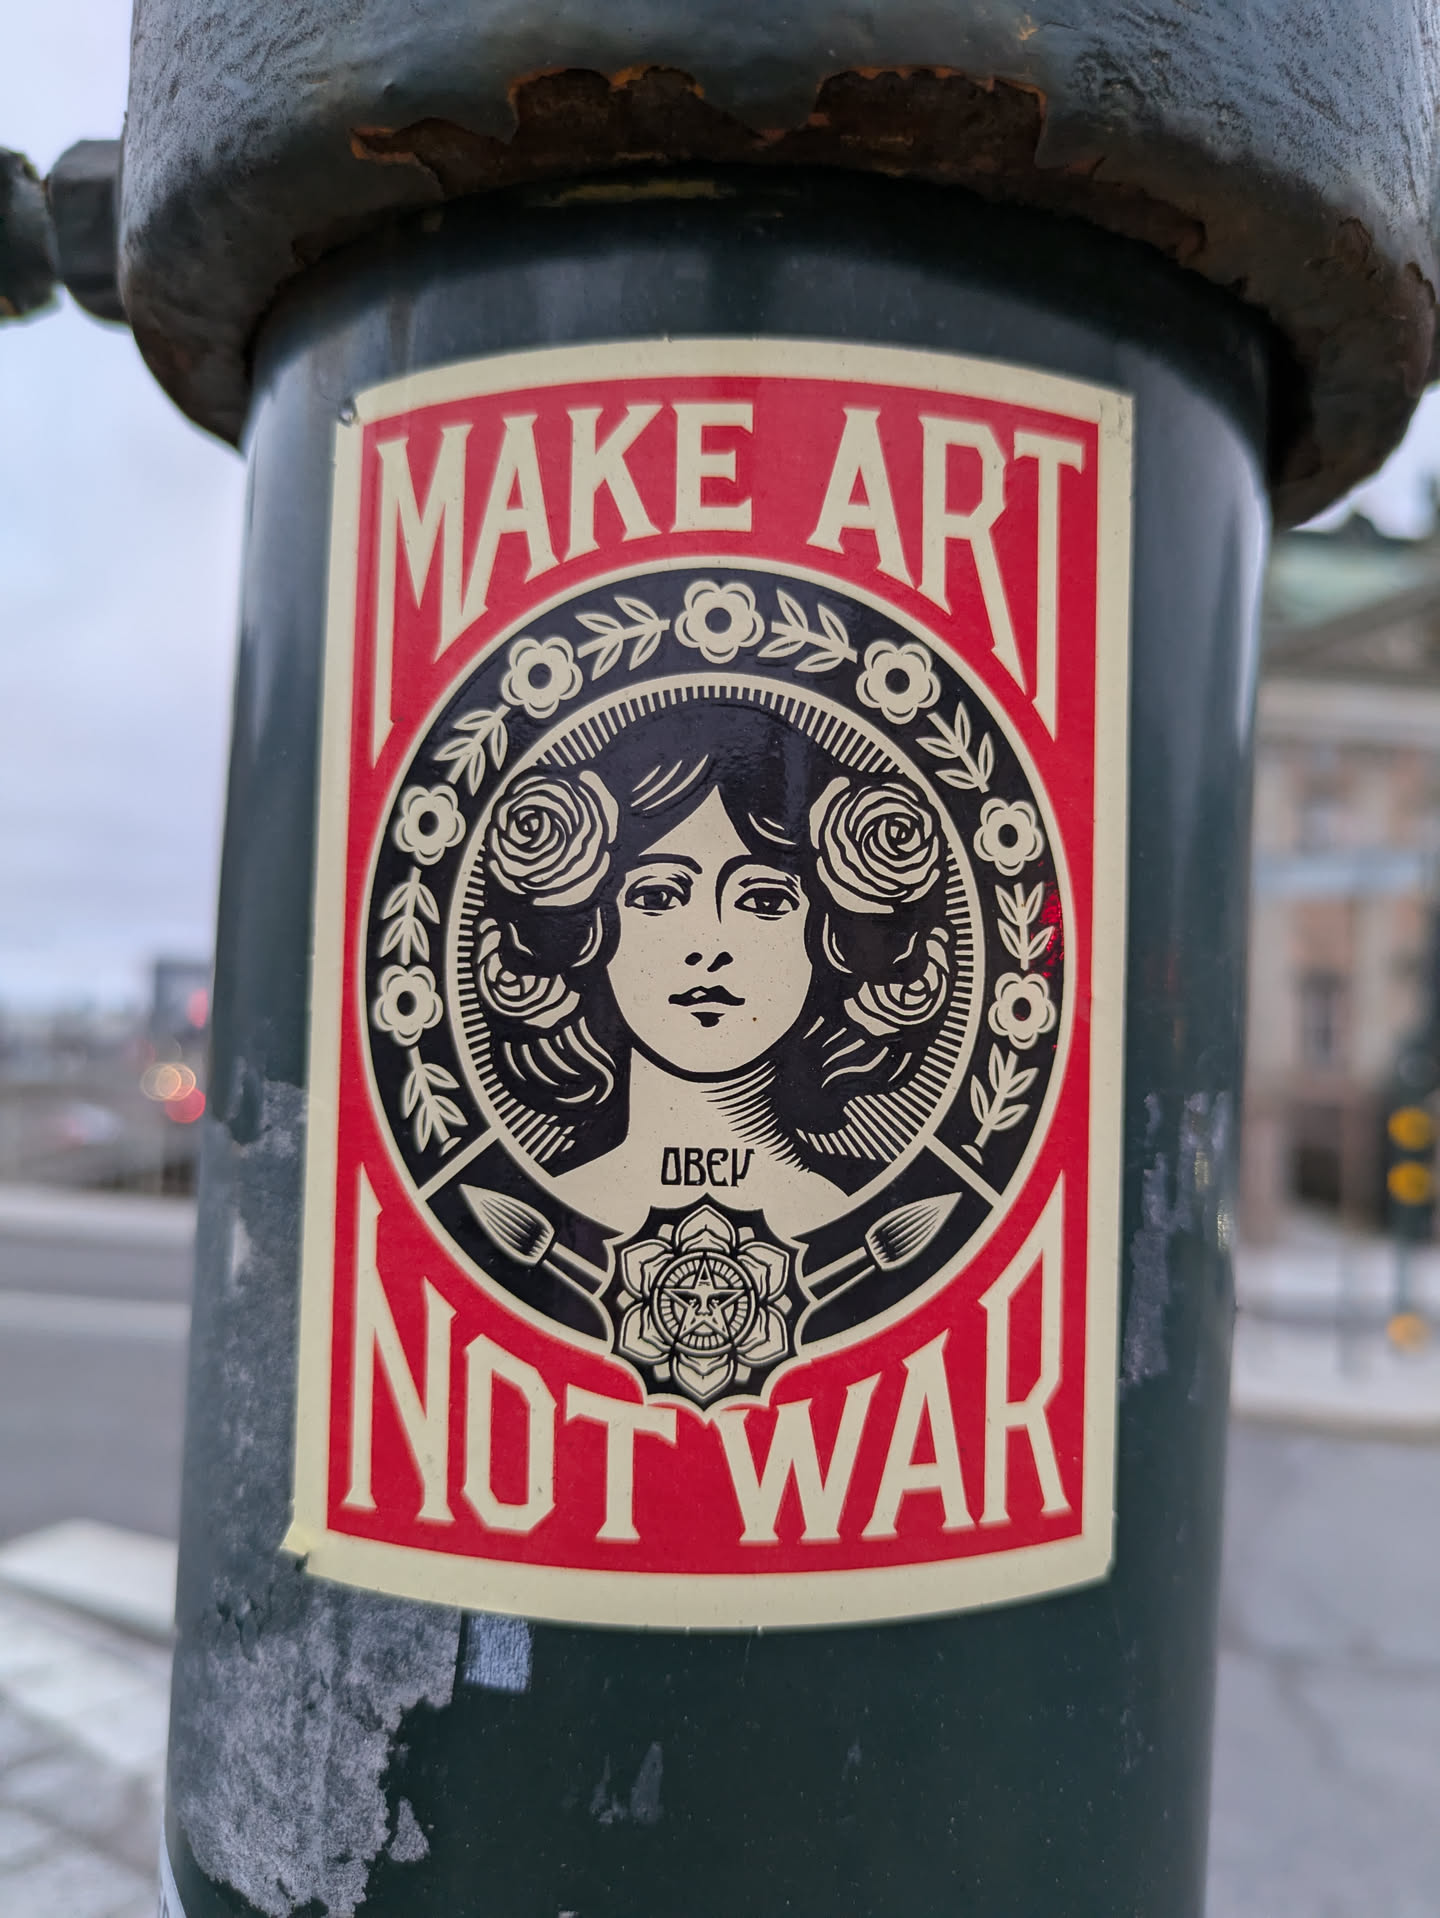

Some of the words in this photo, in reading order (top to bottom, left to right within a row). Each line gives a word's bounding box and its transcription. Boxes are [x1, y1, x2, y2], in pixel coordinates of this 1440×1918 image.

[369, 402, 754, 767] MAKE
[808, 408, 1086, 742] ART
[661, 1147, 755, 1187] OBEY
[341, 1164, 679, 1542] NOT
[710, 1170, 1071, 1545] WAR
